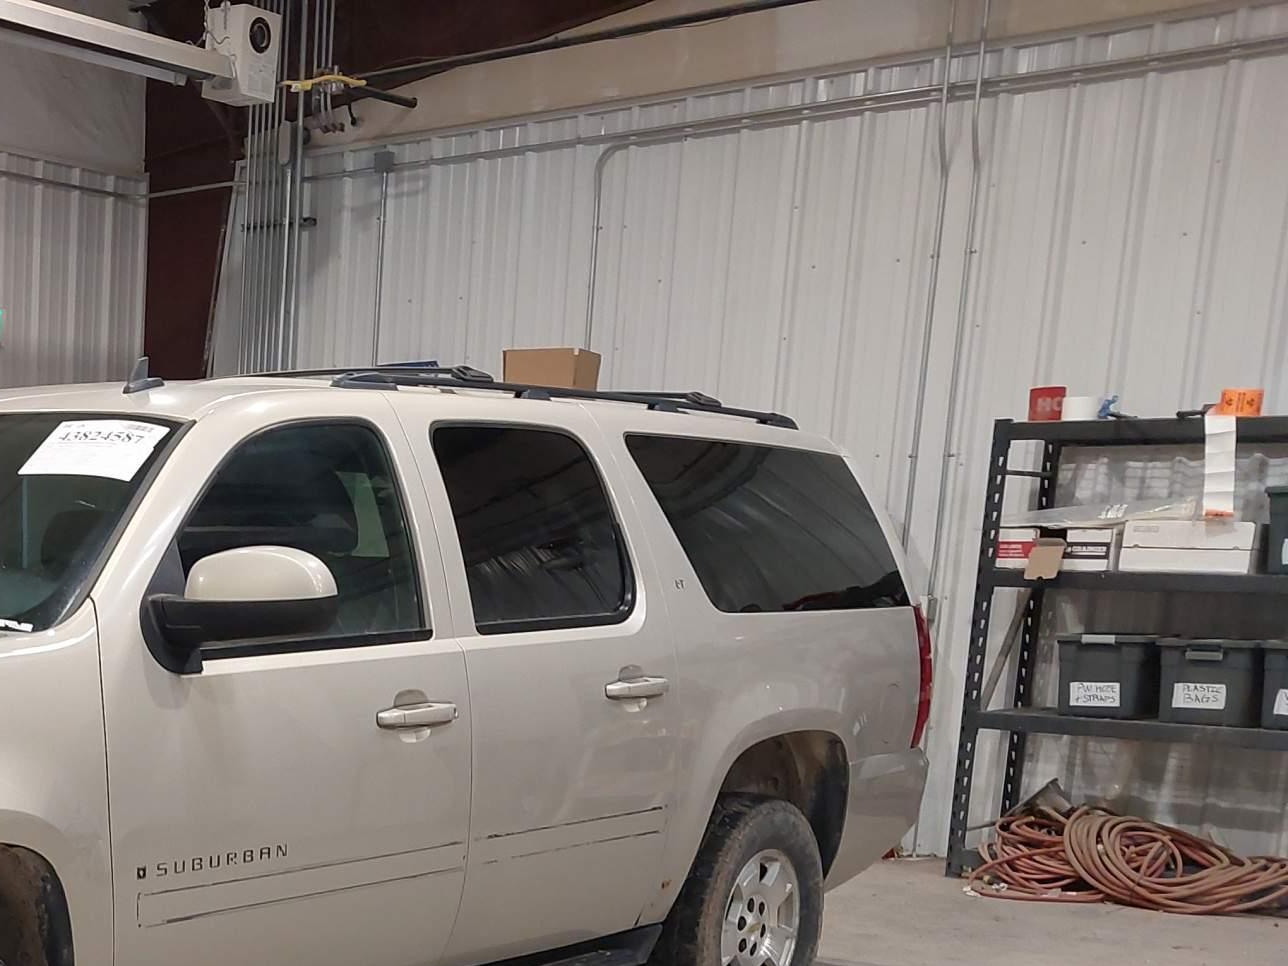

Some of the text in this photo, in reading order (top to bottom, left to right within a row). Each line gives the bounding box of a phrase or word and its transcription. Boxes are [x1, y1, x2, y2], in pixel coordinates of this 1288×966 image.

[59, 431, 145, 444] 43824587
[1183, 693, 1219, 704] BAGS
[156, 843, 288, 877] SUBURBAN
